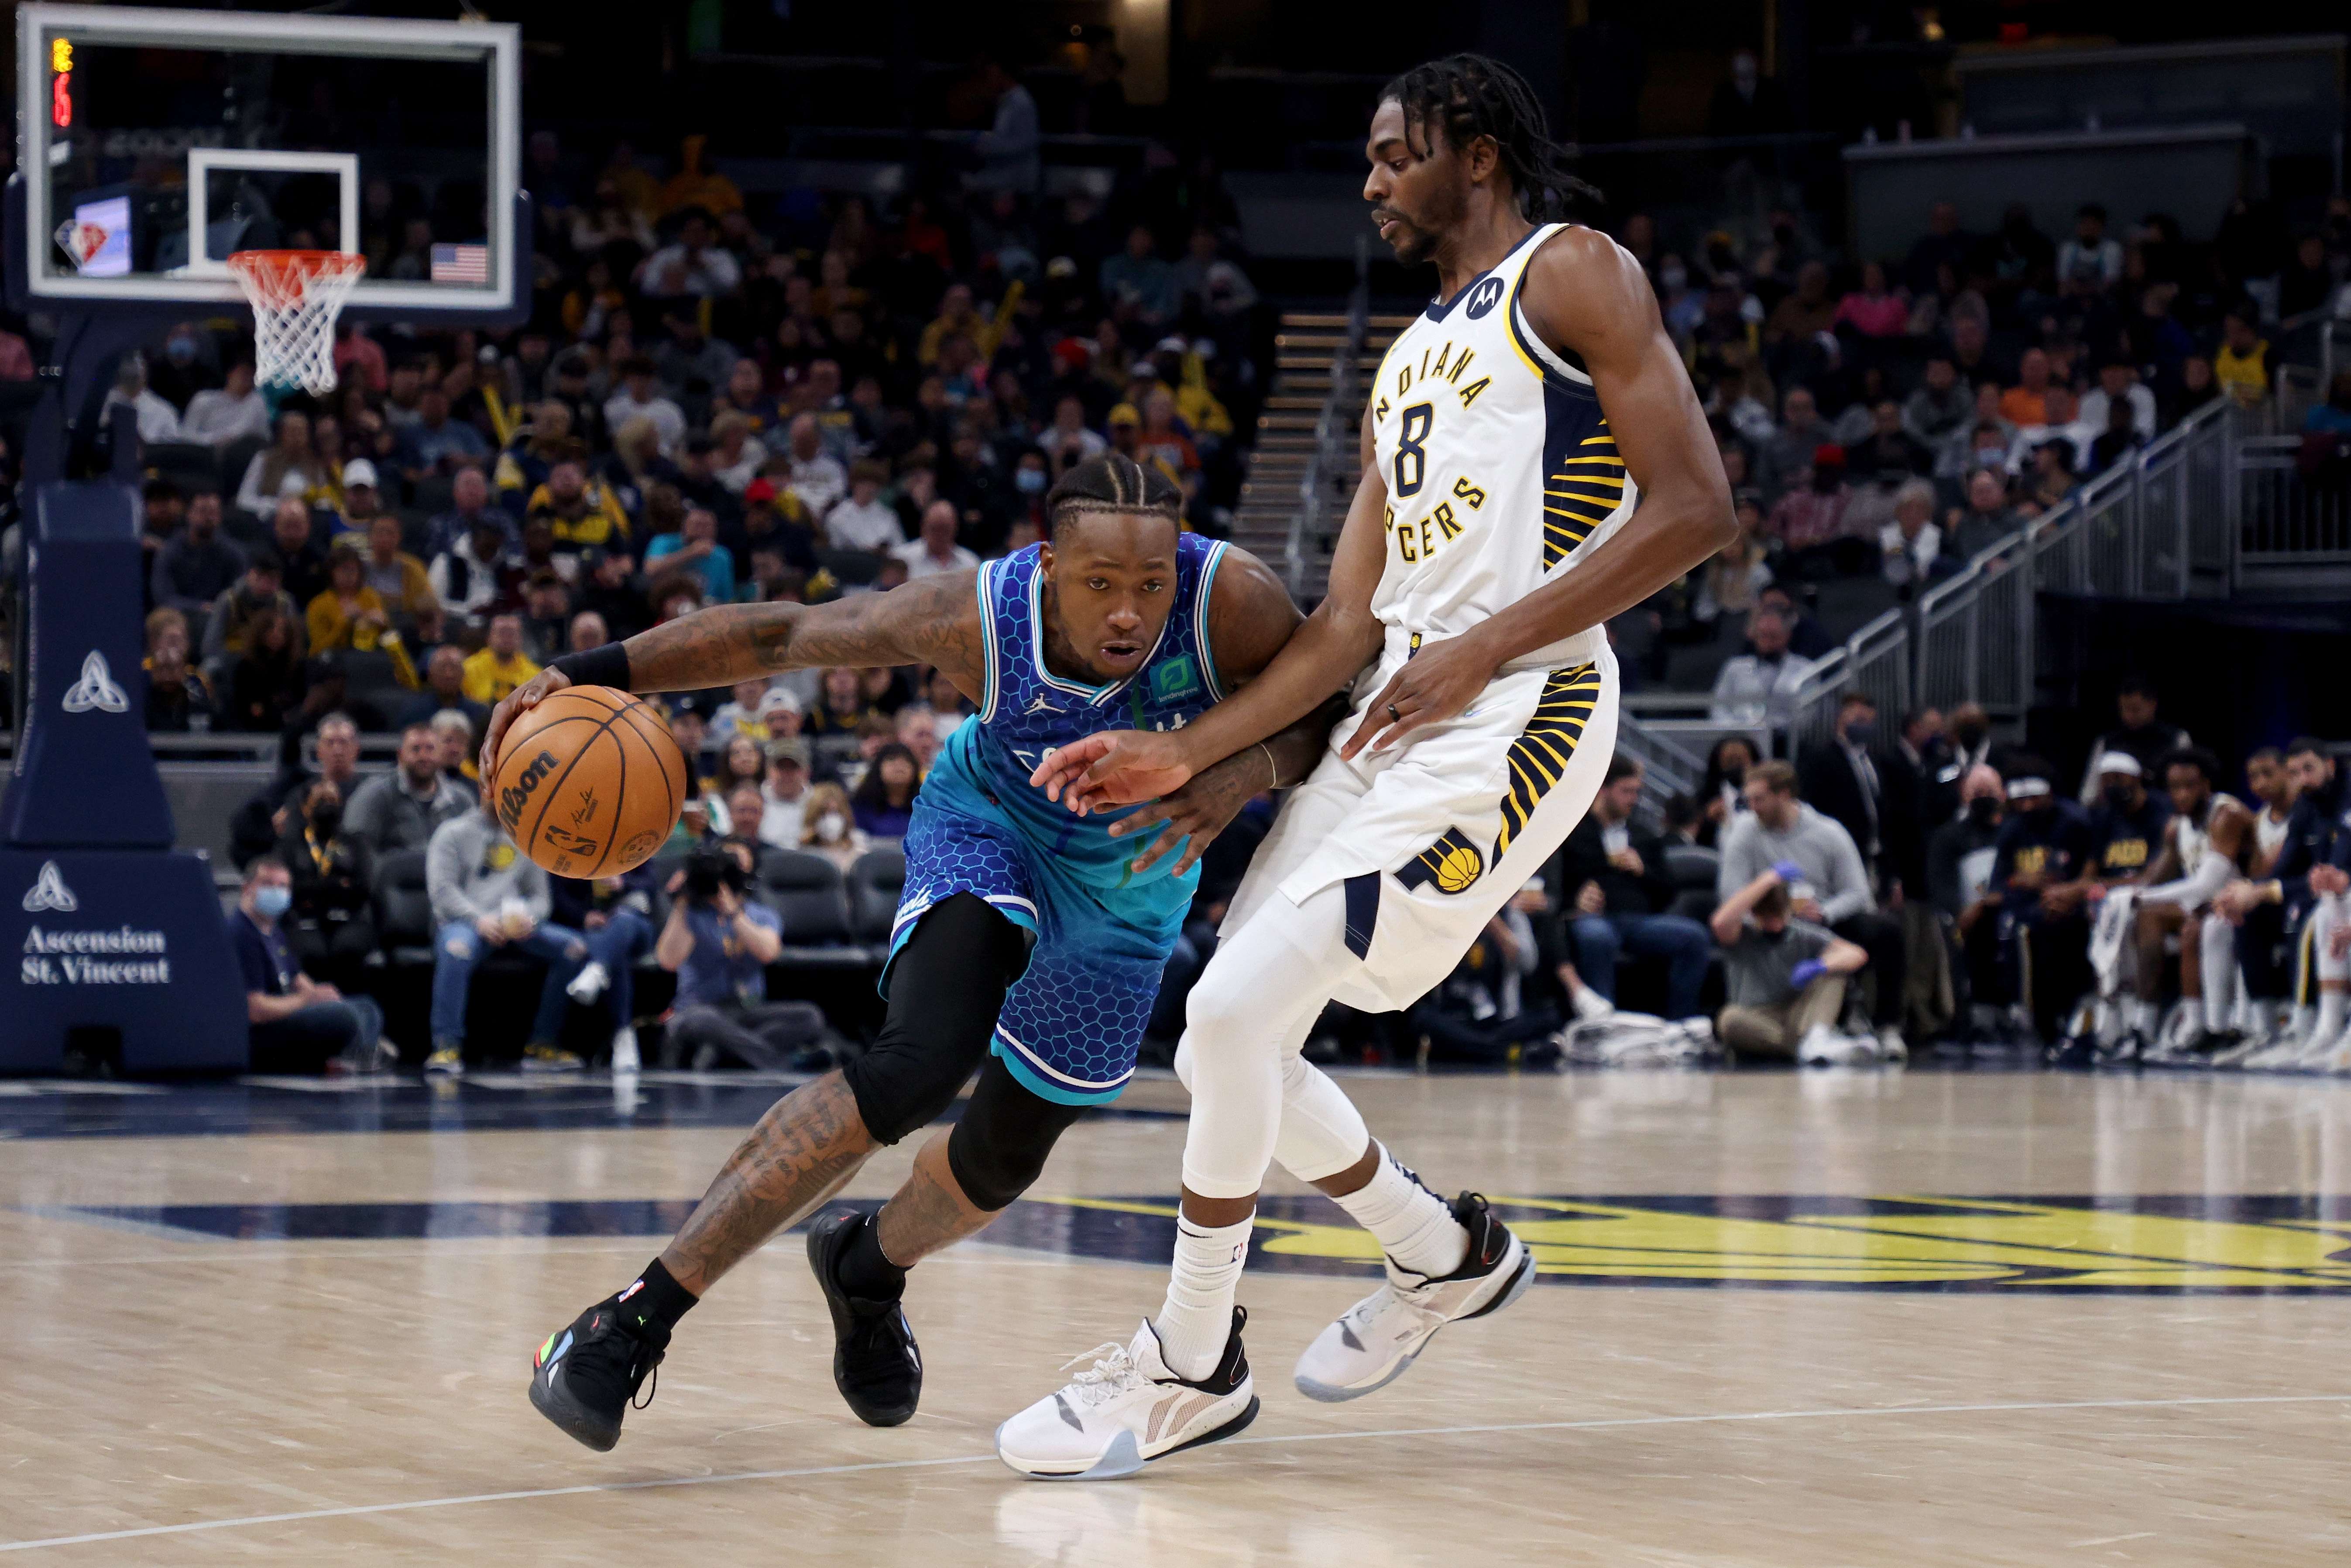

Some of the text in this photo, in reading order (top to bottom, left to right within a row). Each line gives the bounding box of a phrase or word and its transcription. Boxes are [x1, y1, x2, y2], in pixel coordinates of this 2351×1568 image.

[1374, 340, 1493, 436] NDIANA
[1394, 402, 1435, 501] 8
[1158, 687, 1198, 703] lendingtree
[23, 924, 167, 954] Ascension
[21, 956, 170, 984] St. Vincent
